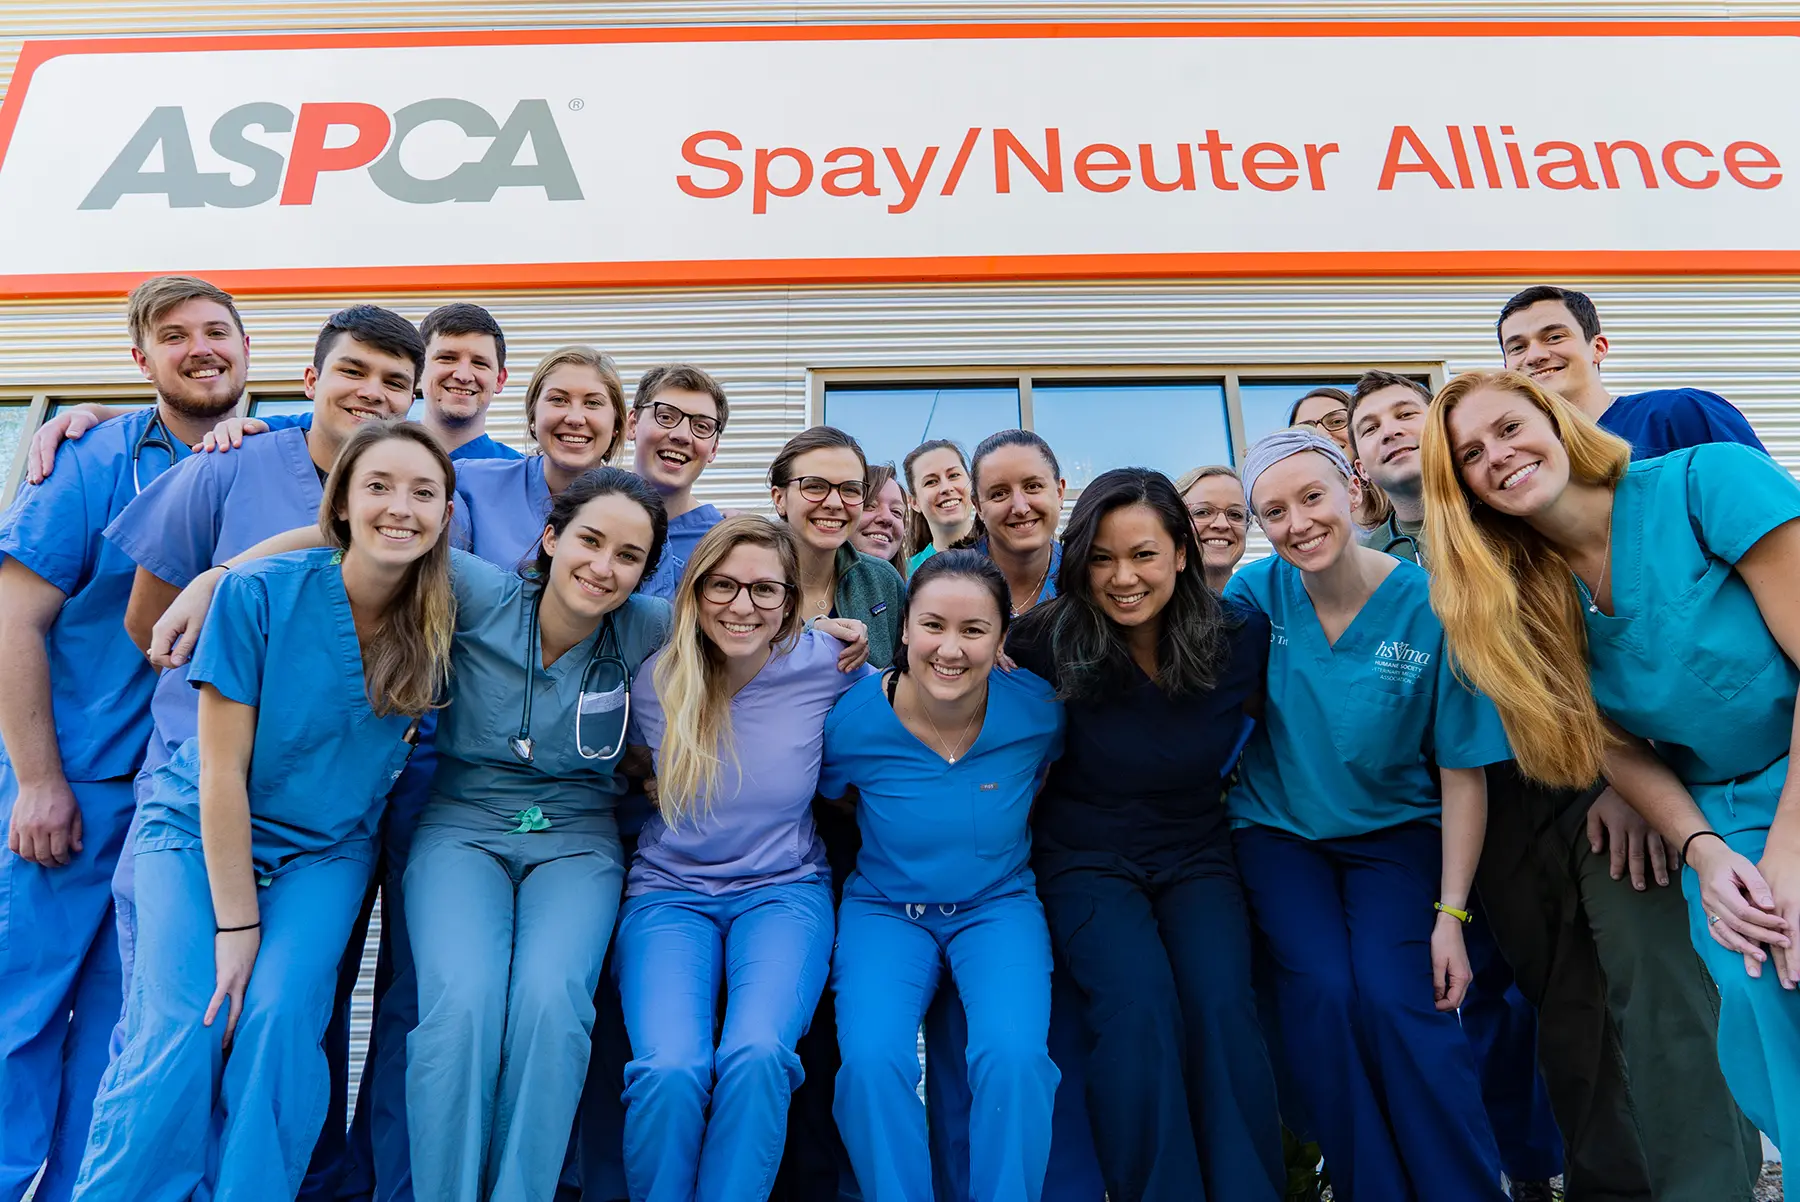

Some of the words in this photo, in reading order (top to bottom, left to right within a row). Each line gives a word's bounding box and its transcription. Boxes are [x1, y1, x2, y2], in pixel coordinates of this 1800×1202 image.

[676, 126, 1340, 214] Spay/Neuter
[1378, 125, 1783, 191] Alliance
[1374, 660, 1400, 669] HUMANE
[1400, 663, 1422, 673] SOCIETY
